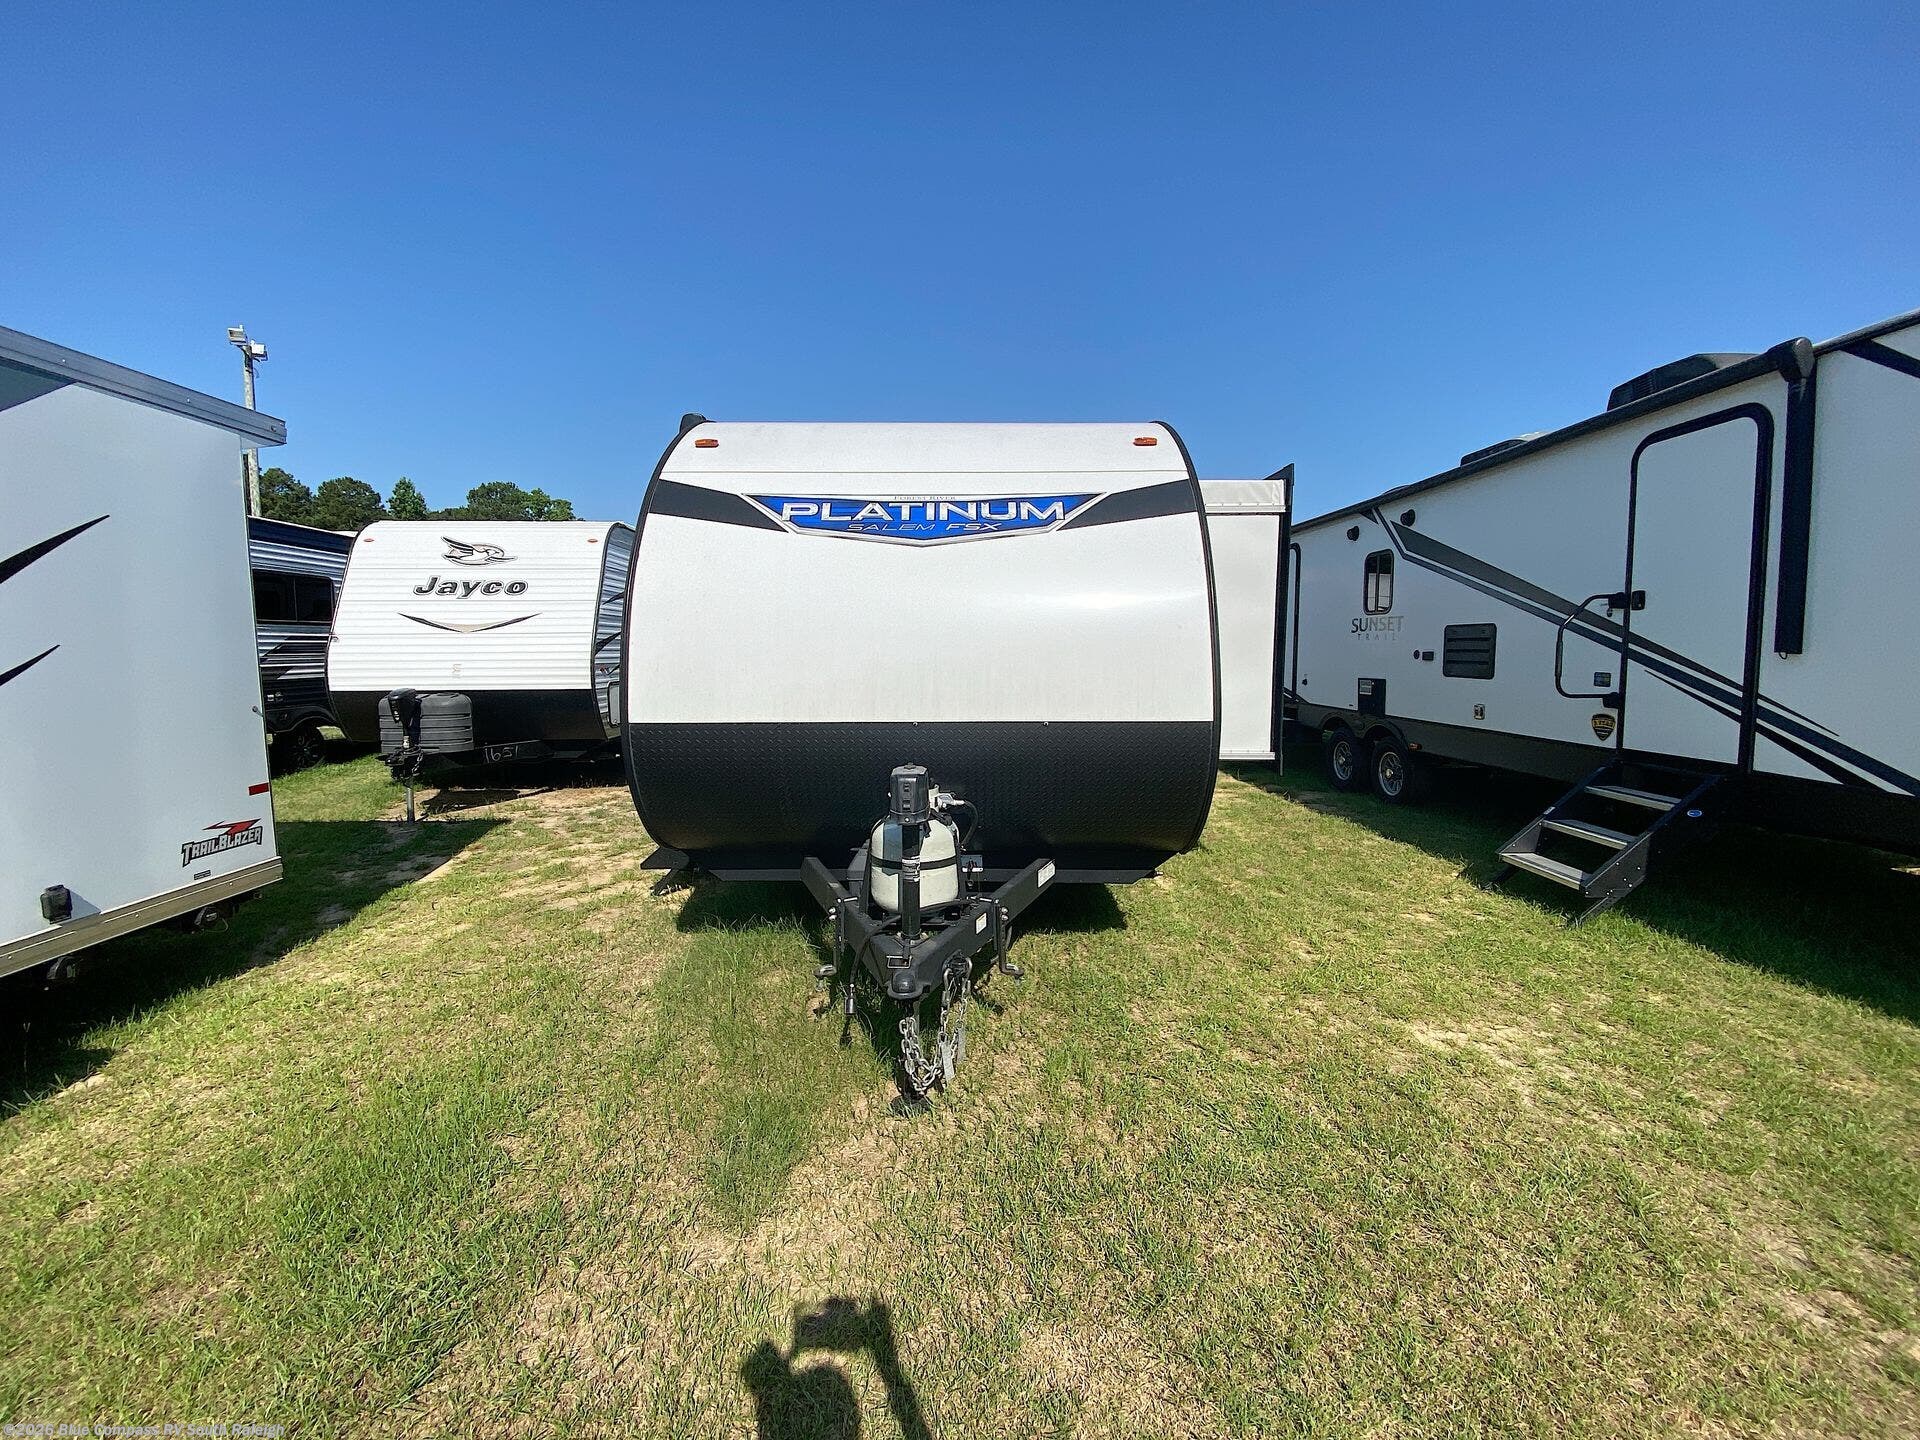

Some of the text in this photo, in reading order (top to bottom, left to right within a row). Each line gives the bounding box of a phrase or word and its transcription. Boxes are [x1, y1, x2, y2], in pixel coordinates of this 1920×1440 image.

[781, 500, 1066, 521] PLATINUM
[848, 522, 1000, 532] SALEM FSX
[413, 575, 528, 599] Jayco
[1350, 615, 1405, 633] SUNSET
[1357, 632, 1398, 641] TRAIL
[181, 825, 263, 868] TRAILBLAZER
